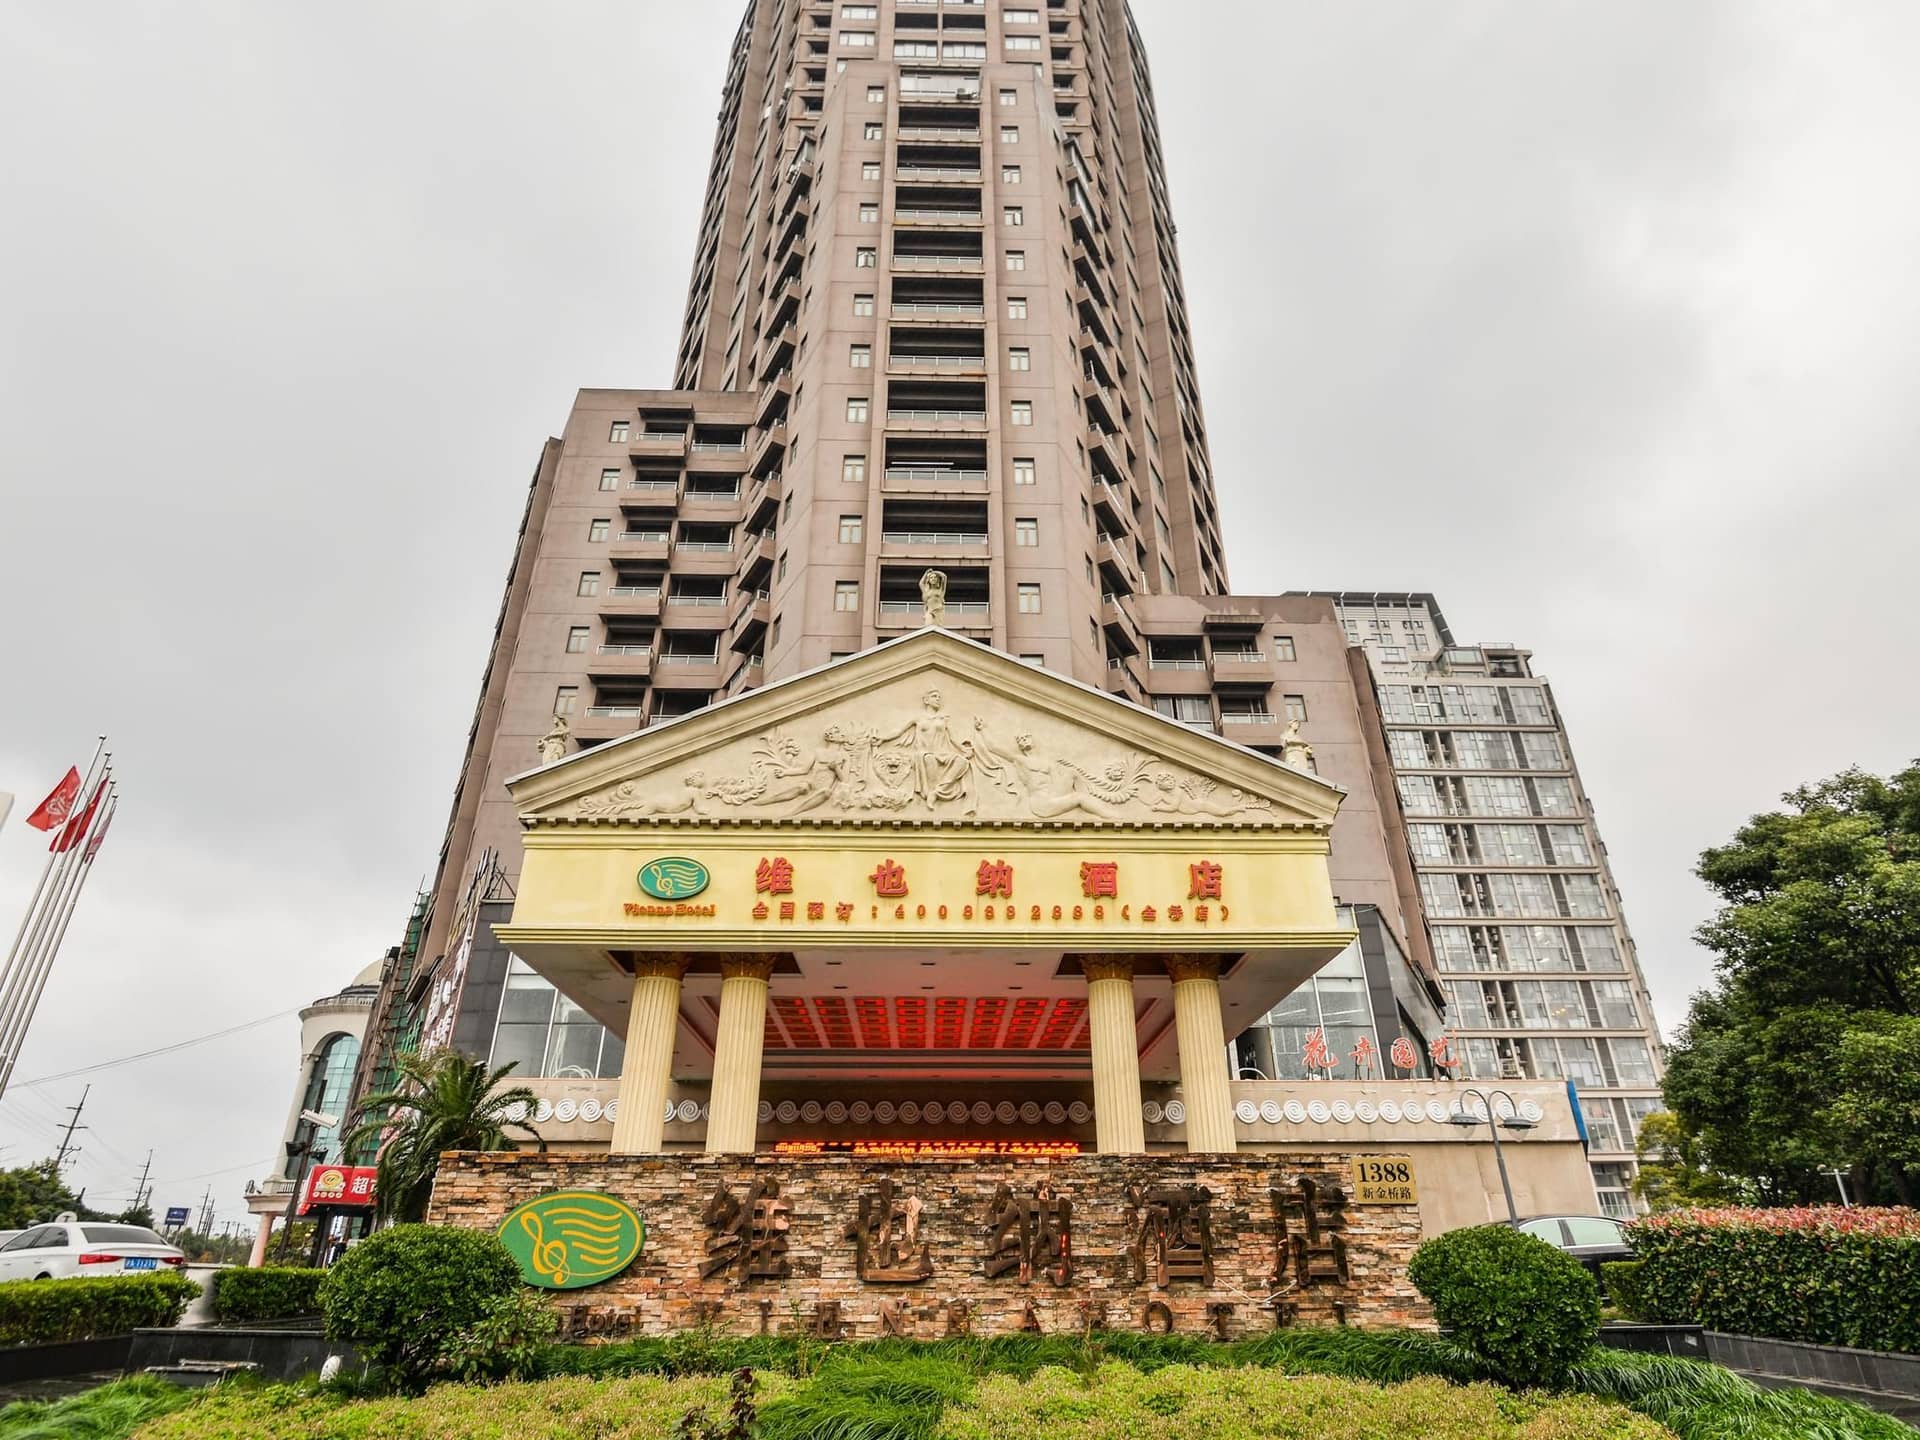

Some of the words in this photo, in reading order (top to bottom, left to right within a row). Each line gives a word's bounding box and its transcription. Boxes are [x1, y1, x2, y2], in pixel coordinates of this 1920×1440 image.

[755, 856, 1223, 900] 维也纳酒店
[623, 903, 674, 917] Vienna
[675, 903, 716, 917] Hotel
[1357, 1162, 1410, 1183] 1388
[1363, 1186, 1411, 1200] 新金桥路
[698, 1176, 1348, 1287] 维也纳酒店
